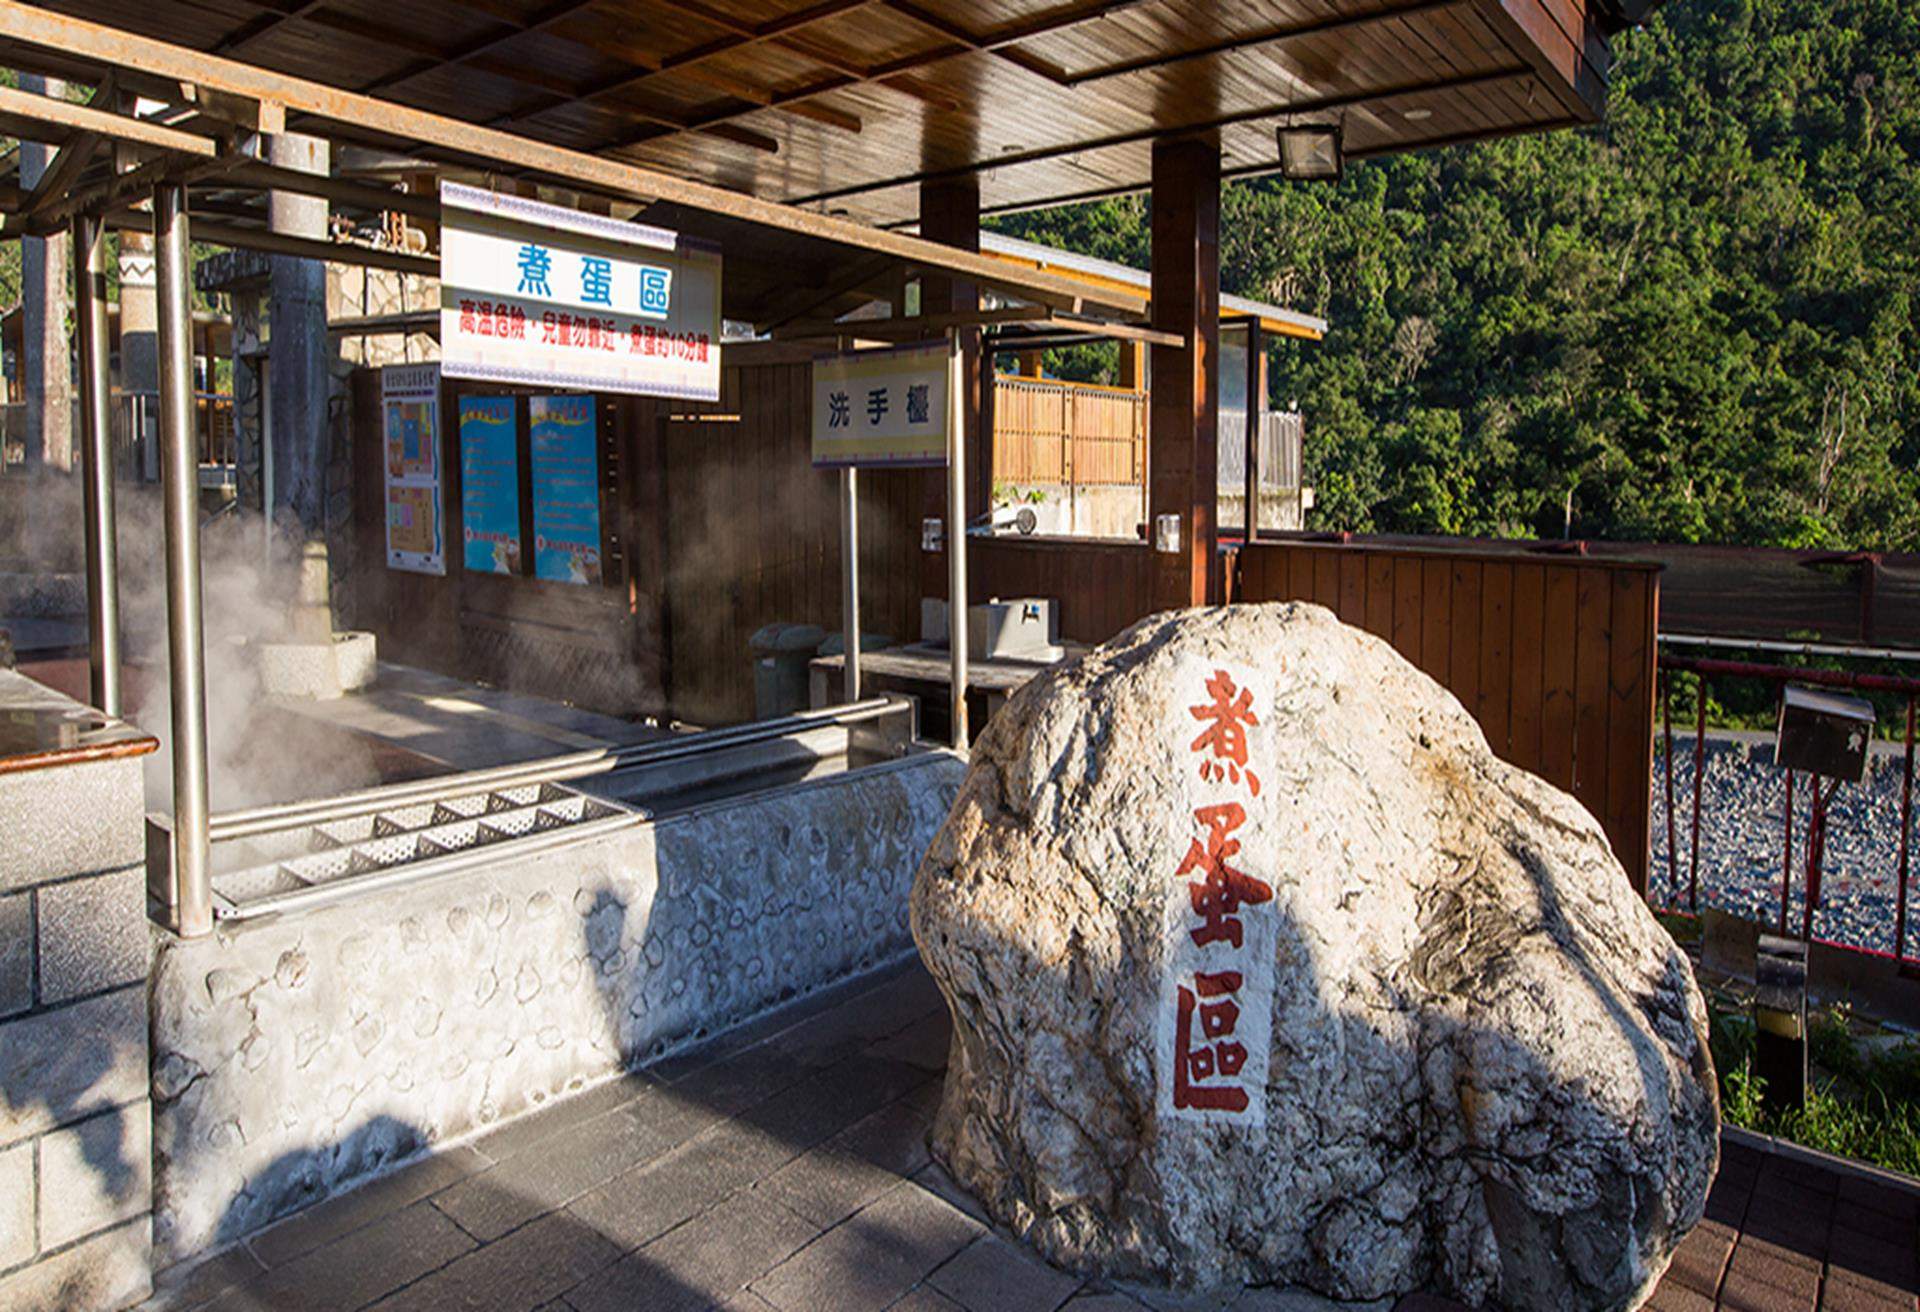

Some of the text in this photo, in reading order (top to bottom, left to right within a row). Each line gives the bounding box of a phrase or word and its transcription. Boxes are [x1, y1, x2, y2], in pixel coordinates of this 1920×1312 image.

[516, 243, 668, 314] 煮蛋區
[1174, 669, 1274, 1113] 煮蛋區
